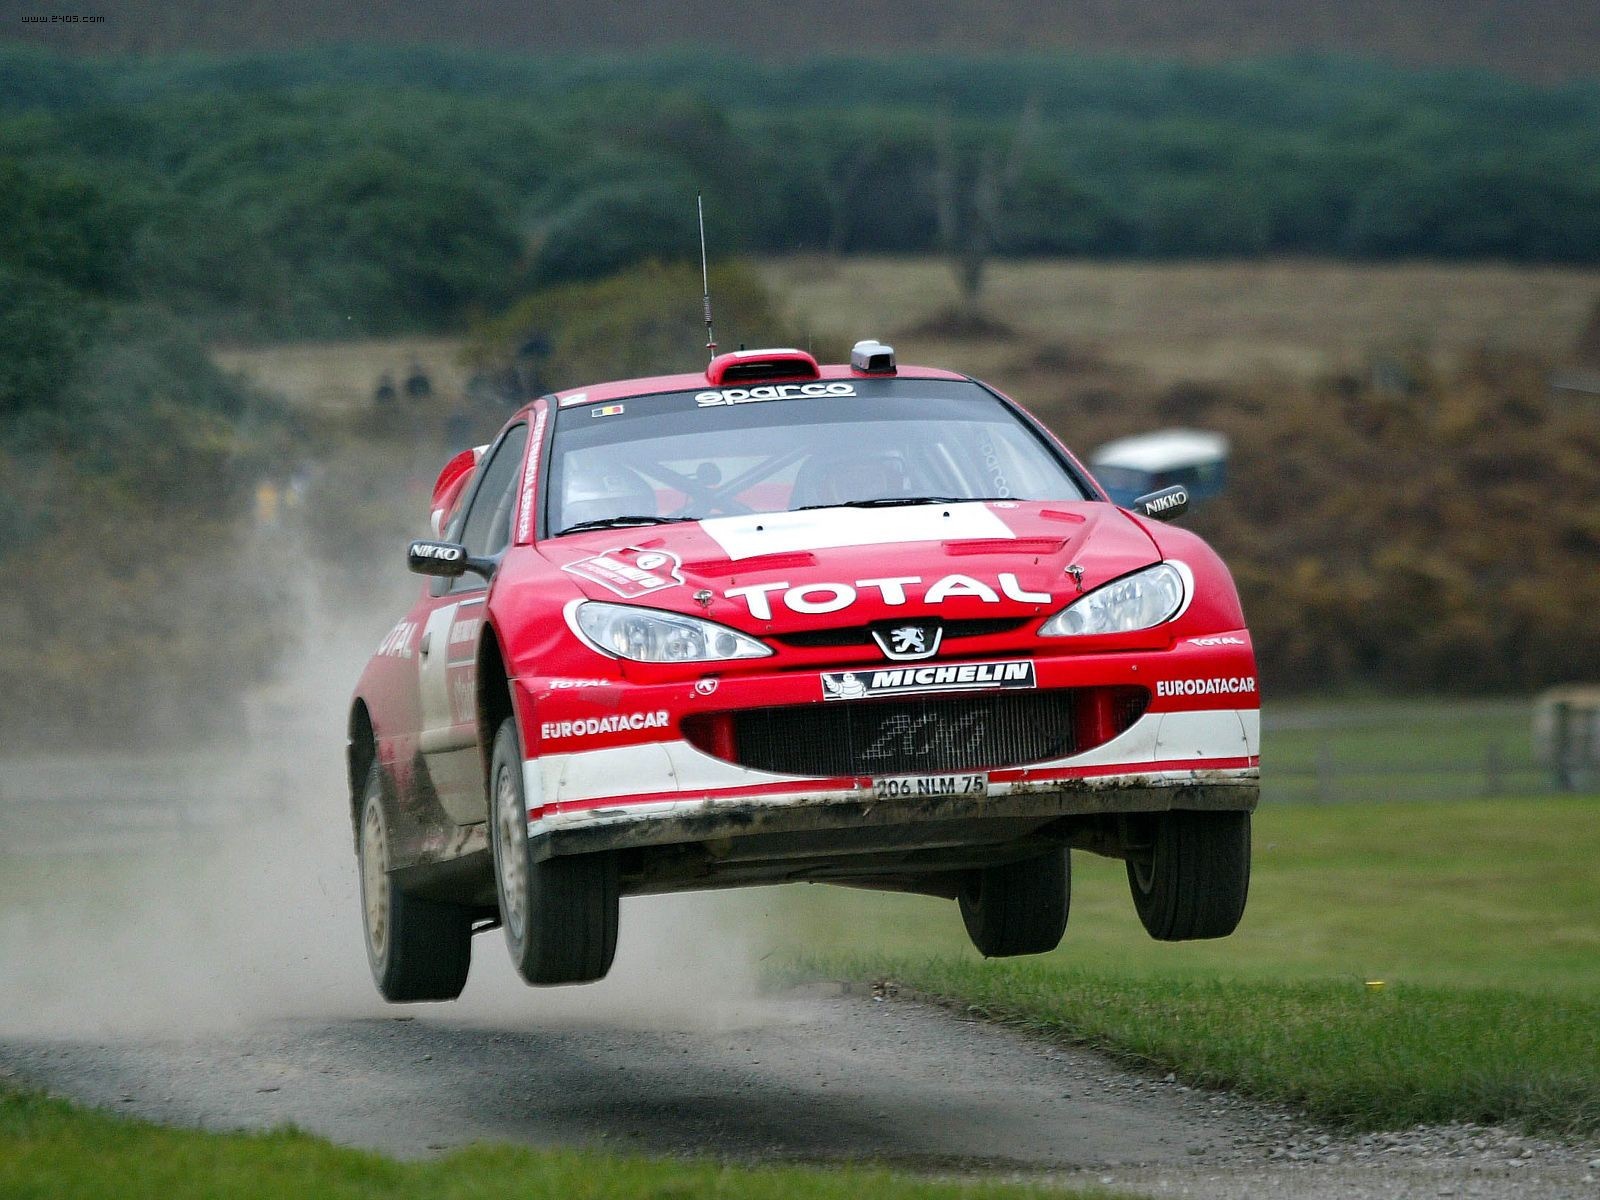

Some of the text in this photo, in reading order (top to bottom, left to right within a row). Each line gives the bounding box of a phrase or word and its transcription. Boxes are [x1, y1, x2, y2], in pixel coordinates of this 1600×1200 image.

[694, 382, 857, 407] sparco
[978, 434, 1010, 498] parco
[1145, 491, 1187, 516] NIKKO
[410, 544, 460, 561] NIKKO
[724, 573, 1052, 621] TOTAL
[1187, 637, 1246, 647] TOTAL
[549, 679, 612, 690] TOTAL
[871, 663, 1029, 688] MICHELIN
[1156, 677, 1255, 697] EURODATACAR
[541, 711, 670, 740] EURODATACAR
[876, 775, 984, 799] 206 NLM 75
